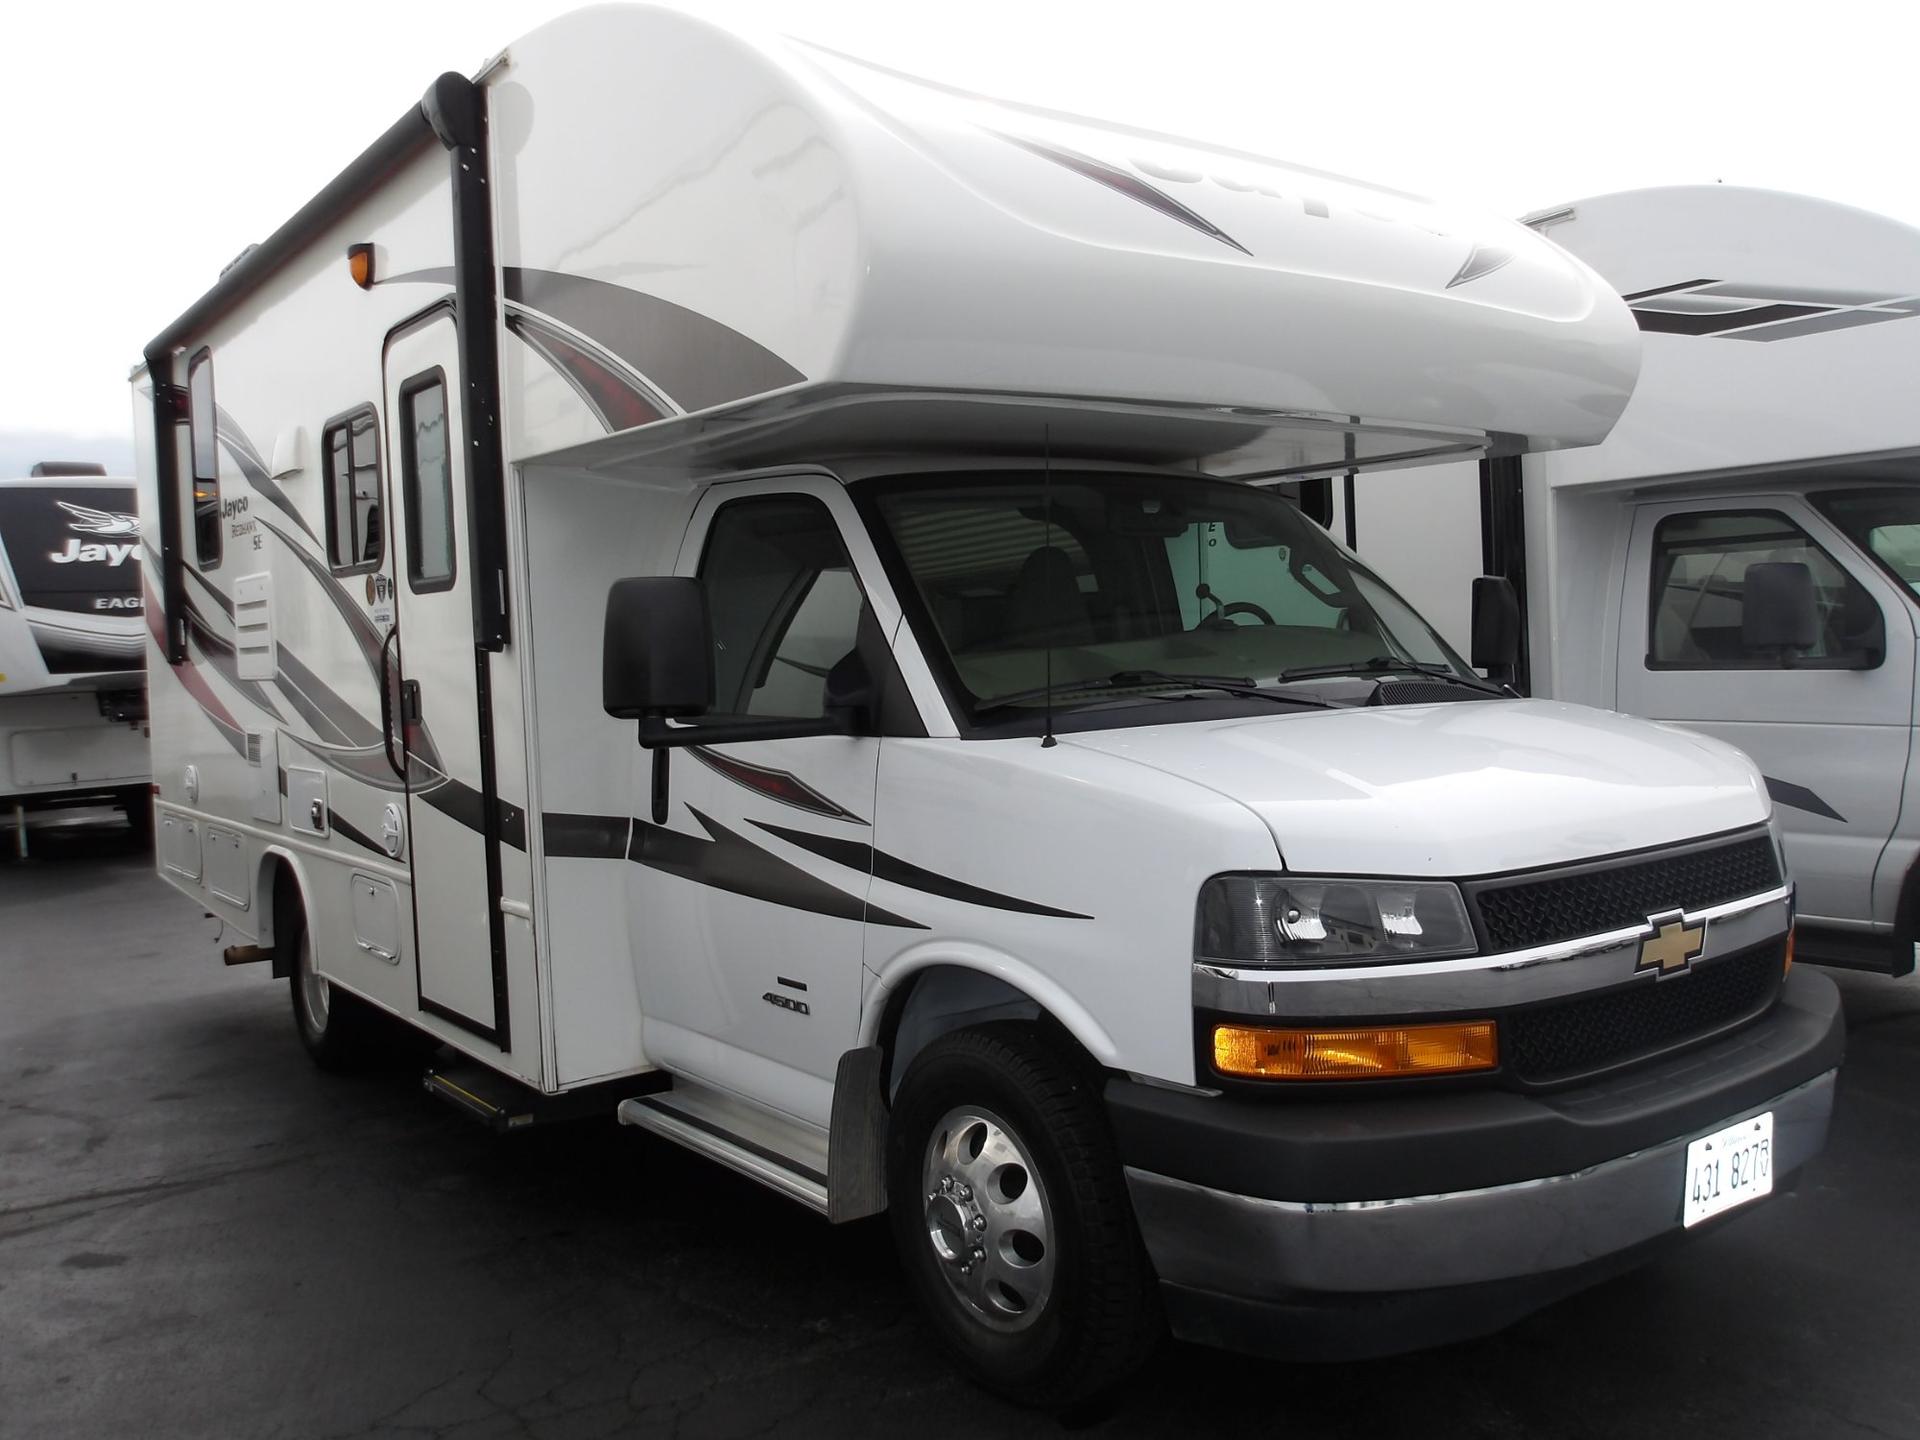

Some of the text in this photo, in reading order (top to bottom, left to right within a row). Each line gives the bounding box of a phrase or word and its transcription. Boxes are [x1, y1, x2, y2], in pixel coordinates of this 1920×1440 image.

[219, 496, 248, 520] Jayco
[762, 992, 810, 1016] 4500
[1692, 1159, 1720, 1204] 431
